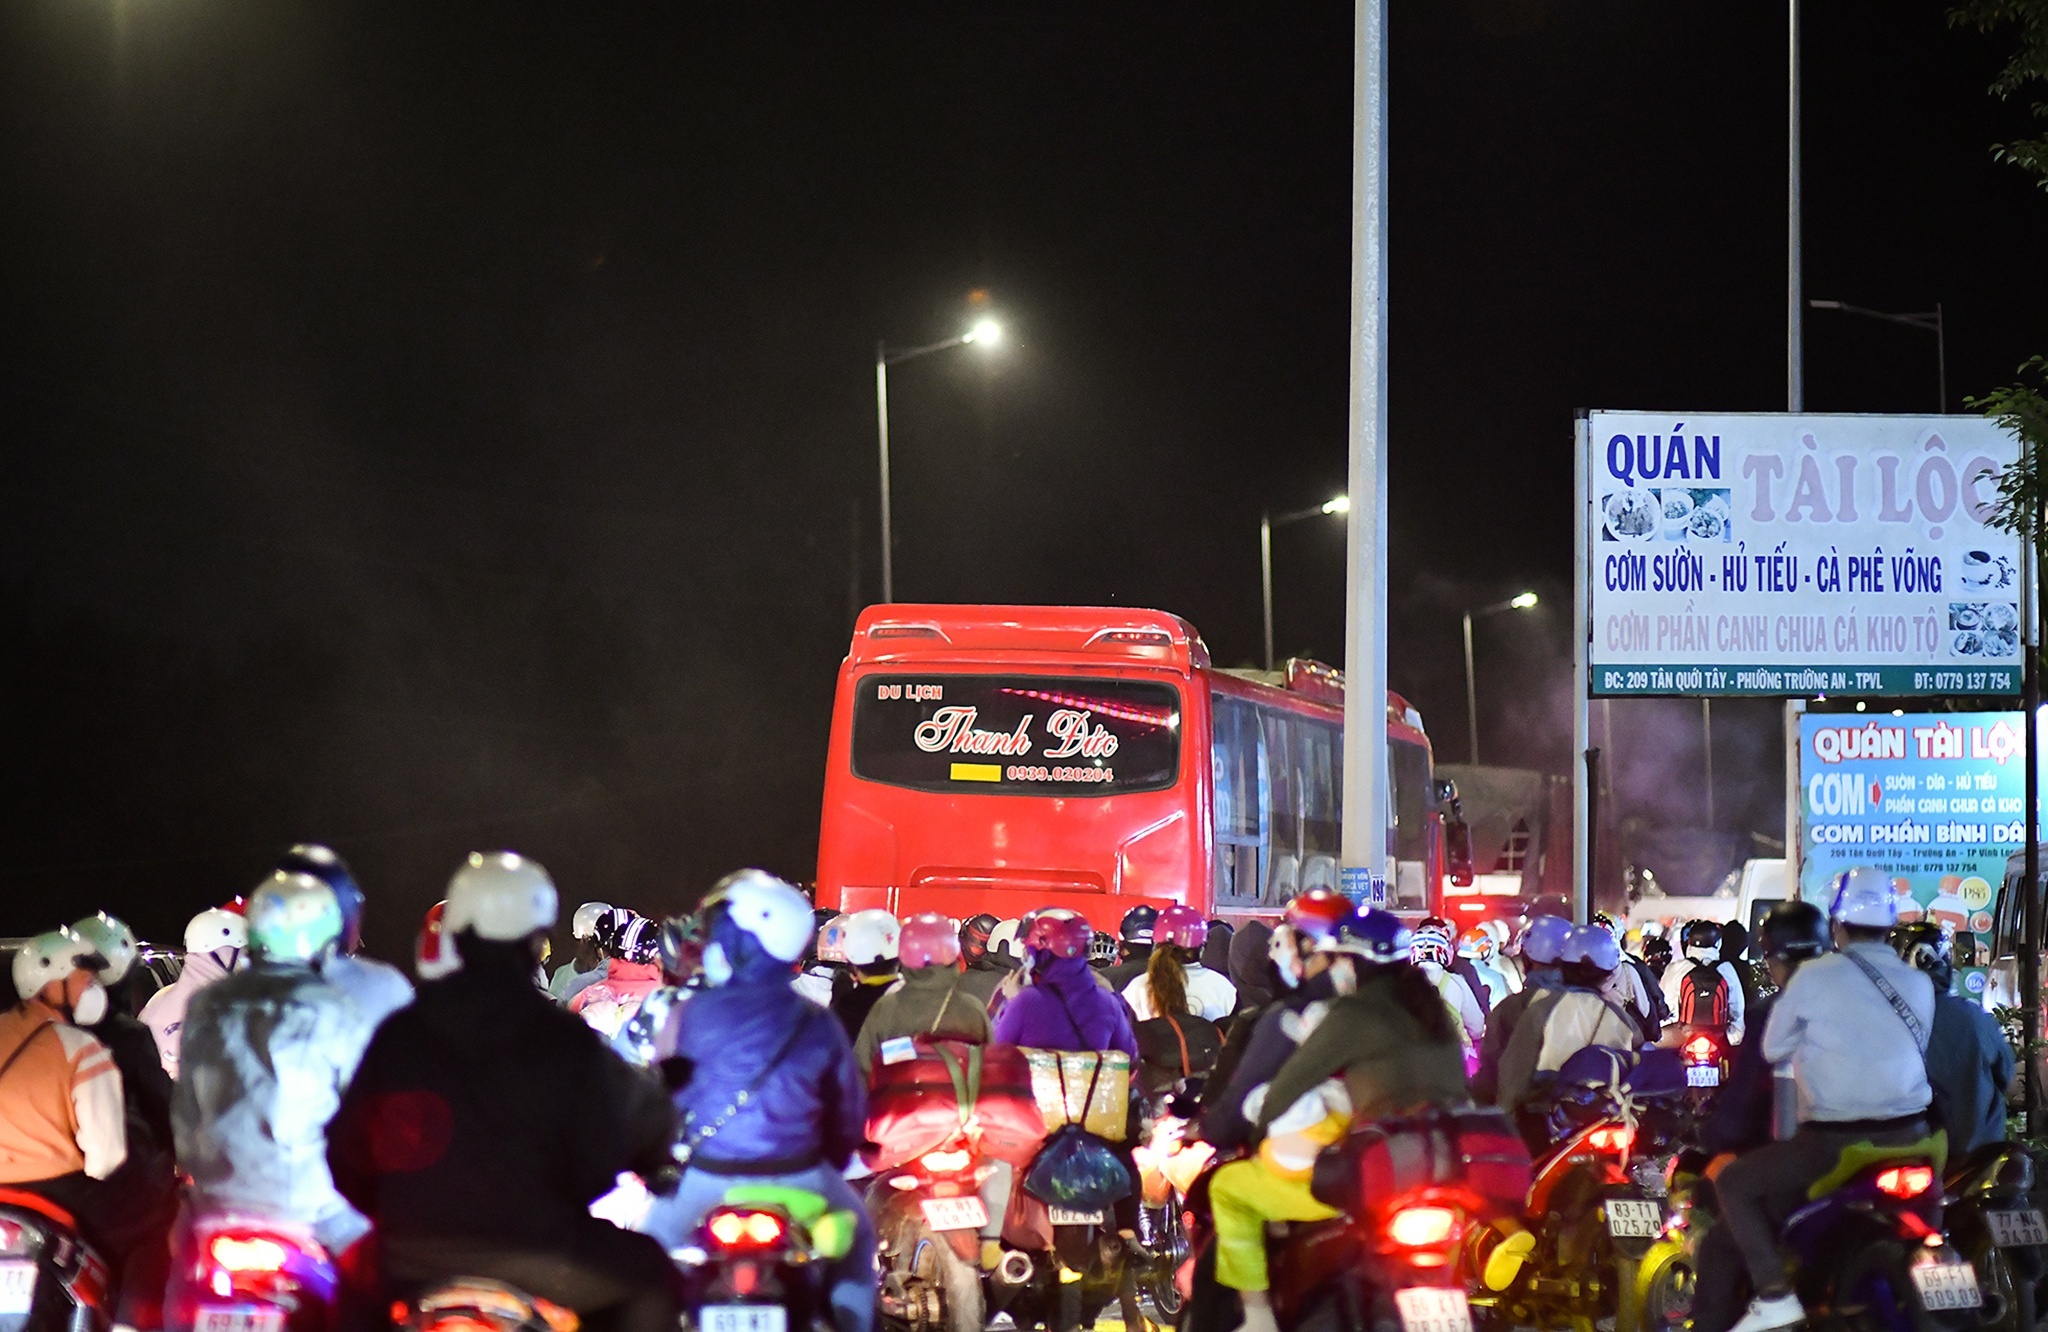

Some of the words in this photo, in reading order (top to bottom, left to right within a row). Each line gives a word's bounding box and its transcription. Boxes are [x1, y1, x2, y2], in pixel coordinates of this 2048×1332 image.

[1606, 423, 1721, 488] QUÁN
[1743, 434, 1859, 524] TÀI
[1877, 433, 2003, 540] LỘC
[1605, 549, 1647, 592] CƠM
[1652, 545, 1703, 592] SƯỜN
[1722, 541, 1748, 593] HỦ
[1754, 541, 1798, 593] TIẾU
[1816, 546, 1841, 593] CÀ
[1848, 546, 1884, 593] PHÊ
[1891, 547, 1942, 594] VÕNG
[1606, 609, 1649, 652] CƠM
[1656, 599, 1709, 652] PHẦN
[1716, 615, 1768, 652] CANH
[1775, 615, 1827, 653] CHUA
[1834, 606, 1859, 653] CÁ
[1866, 615, 1907, 653] KHO
[1912, 606, 1939, 660] TỘ
[1604, 671, 1624, 689] ĐC:
[1626, 671, 1648, 689] 209
[1650, 667, 1673, 689] TÂN
[1675, 667, 1702, 691] QUỚI
[1704, 667, 1727, 689] TÂY
[1736, 667, 1781, 690] PHƯỜNG
[1784, 668, 1828, 690] TRƯỜNG
[1830, 672, 1846, 690] AN
[1855, 672, 1883, 690] TPVL
[1914, 672, 1933, 690] ĐT:
[1935, 672, 1963, 690] 0779
[1966, 672, 1986, 690] 137
[1990, 672, 2011, 690] 754
[878, 685, 902, 700] DU
[905, 684, 943, 702] LỊCH
[914, 705, 1034, 756] Thanh
[1043, 708, 1118, 758] Đức
[1813, 721, 1906, 764] QUÁN
[1913, 721, 1964, 760] TÀI
[1006, 765, 1114, 783] 0939.020204
[1955, 771, 1972, 791] HỦ
[1973, 769, 1998, 791] TIẾU
[1808, 772, 1865, 816] CƠM
[1917, 798, 1947, 814] CANH
[1949, 798, 1979, 814] CHUA
[1980, 795, 1996, 814] CÁ
[1998, 798, 2023, 814] KHO
[1935, 818, 1988, 844] BÌNH
[1967, 848, 1977, 857] TP
[1614, 1203, 1652, 1218] 83-T1
